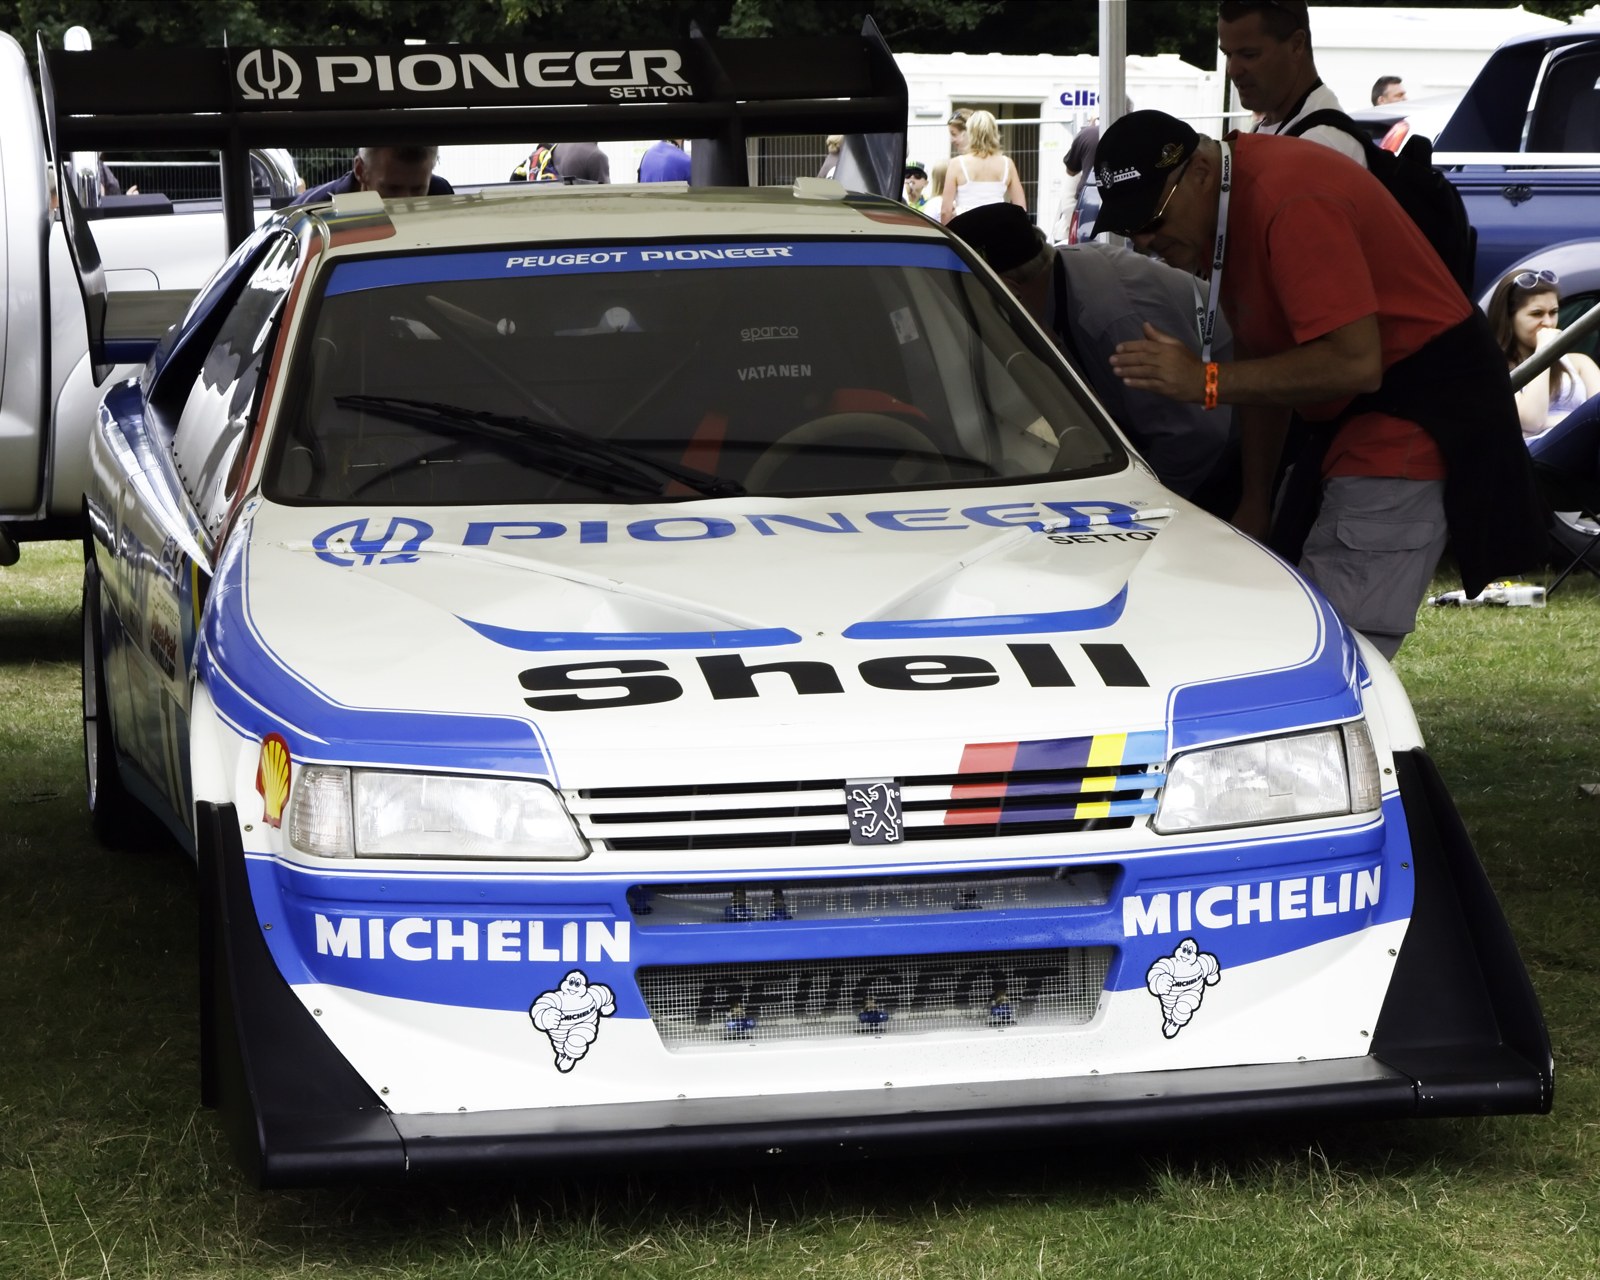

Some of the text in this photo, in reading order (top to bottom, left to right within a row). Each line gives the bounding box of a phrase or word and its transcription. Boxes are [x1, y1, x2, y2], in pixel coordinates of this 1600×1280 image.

[315, 49, 689, 92] PIONEER
[609, 84, 694, 99] SETTON
[1060, 90, 1099, 106] elli
[506, 246, 794, 268] PEUGEOT PIONEER
[740, 325, 799, 342] sparco
[737, 364, 812, 381] VATANEN
[1123, 865, 1382, 938] MICHELIN
[315, 914, 631, 962] MICHELIN
